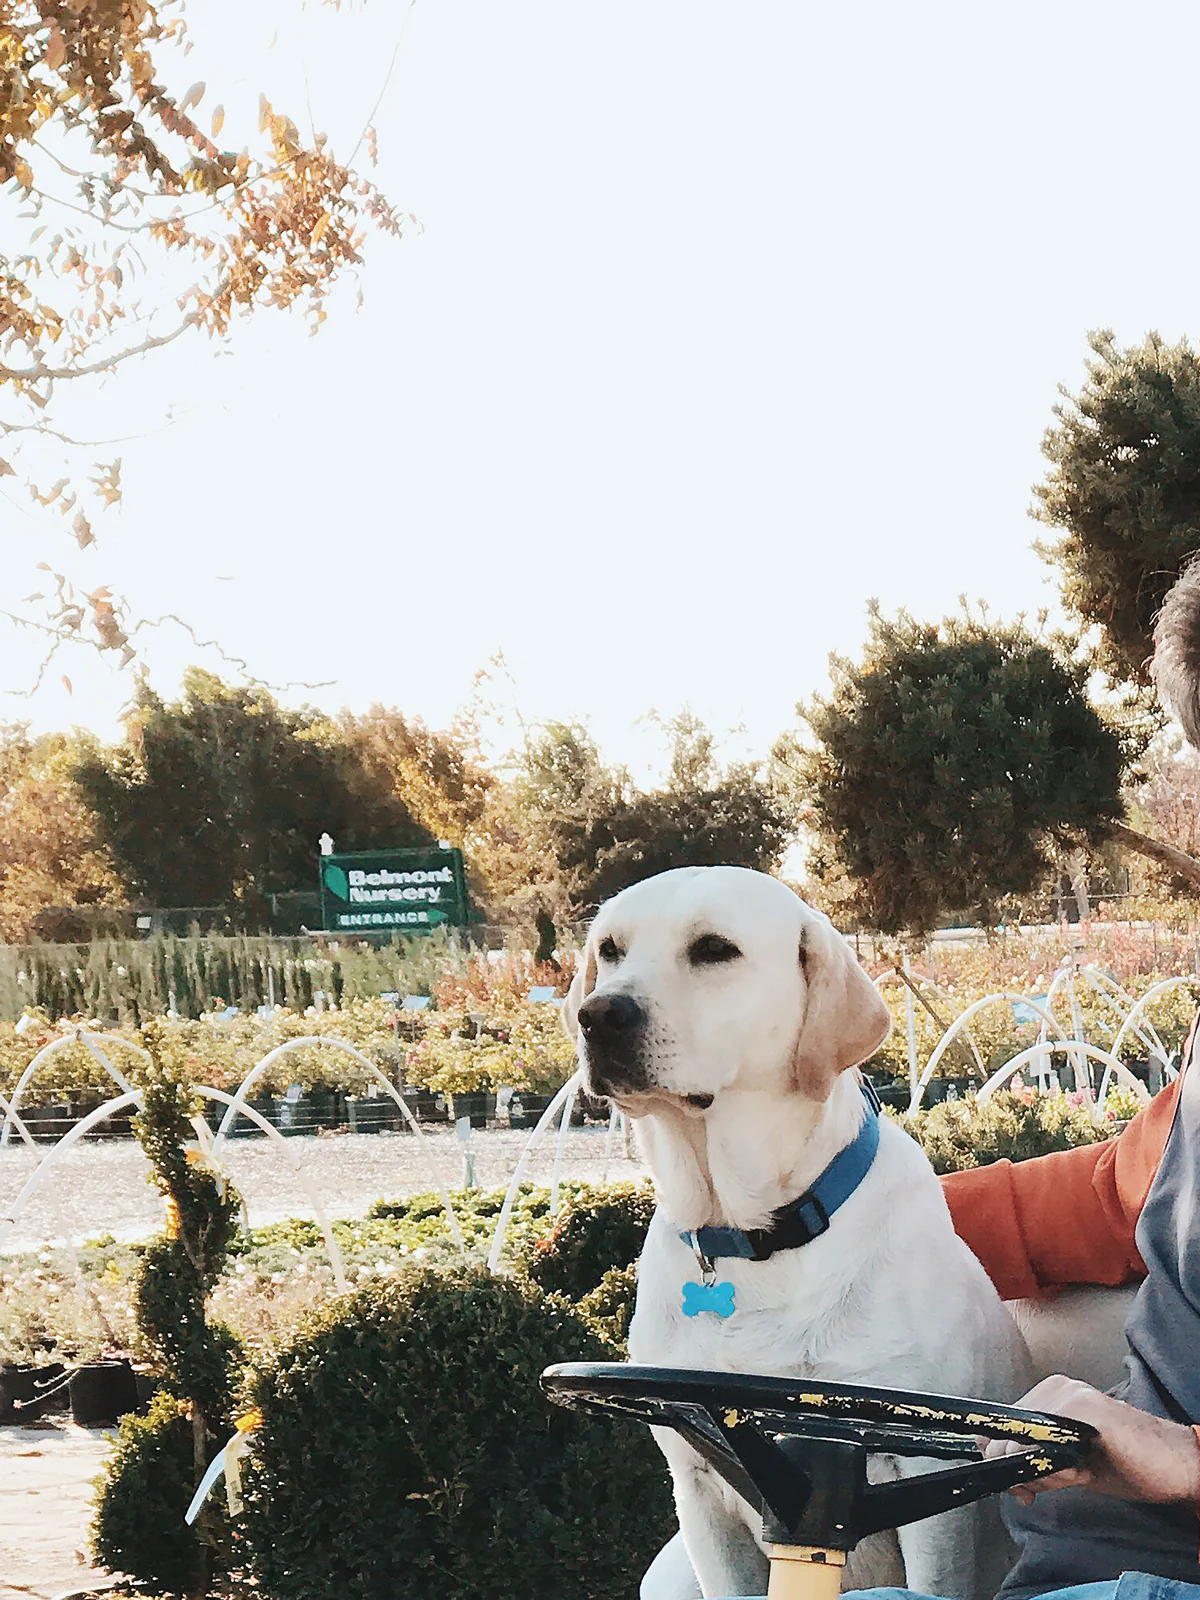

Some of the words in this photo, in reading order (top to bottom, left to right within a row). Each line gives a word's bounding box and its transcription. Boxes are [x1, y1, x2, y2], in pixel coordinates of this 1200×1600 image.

[349, 866, 453, 885] Belmont
[350, 886, 441, 903] Nursery
[340, 911, 428, 925] ENTRANCE
